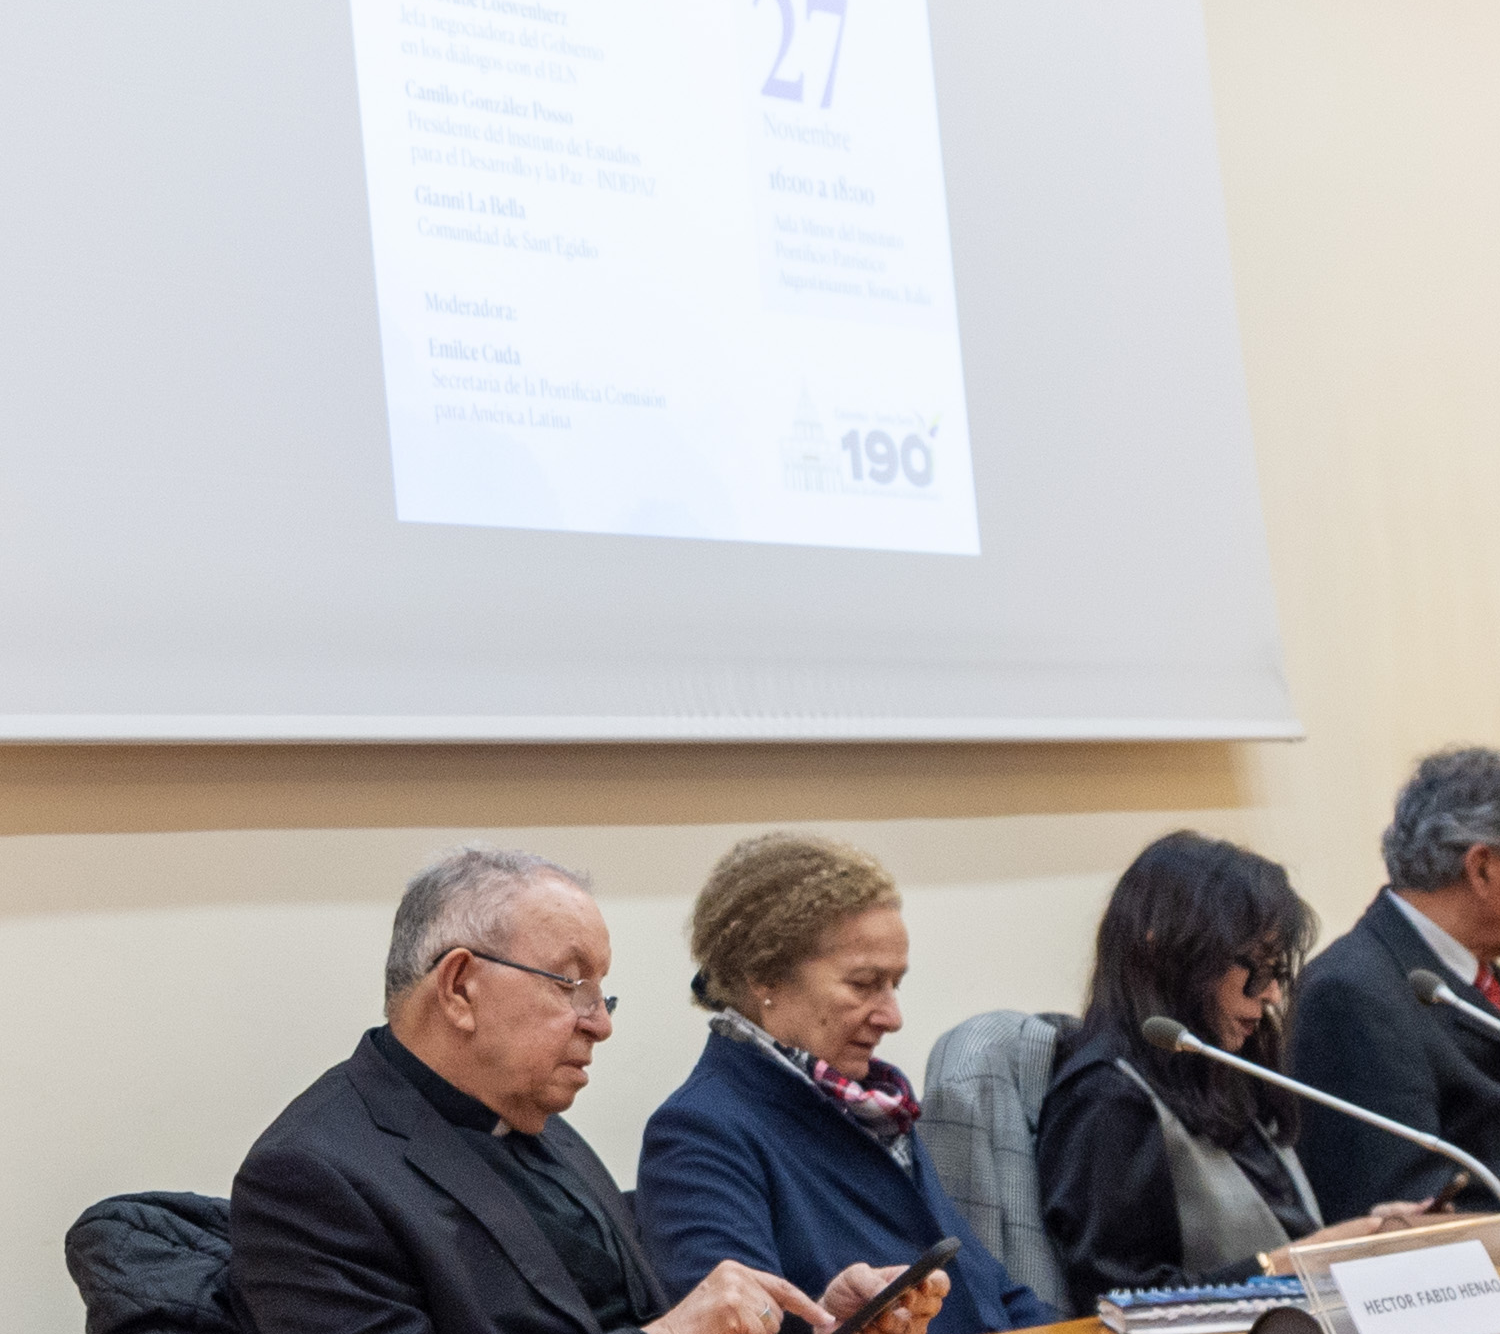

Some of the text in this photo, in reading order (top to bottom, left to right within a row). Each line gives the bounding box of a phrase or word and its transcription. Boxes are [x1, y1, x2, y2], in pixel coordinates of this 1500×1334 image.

[840, 429, 934, 488] 190
[1363, 1293, 1415, 1316] HECTOR
[1416, 1285, 1457, 1305] FABIO
